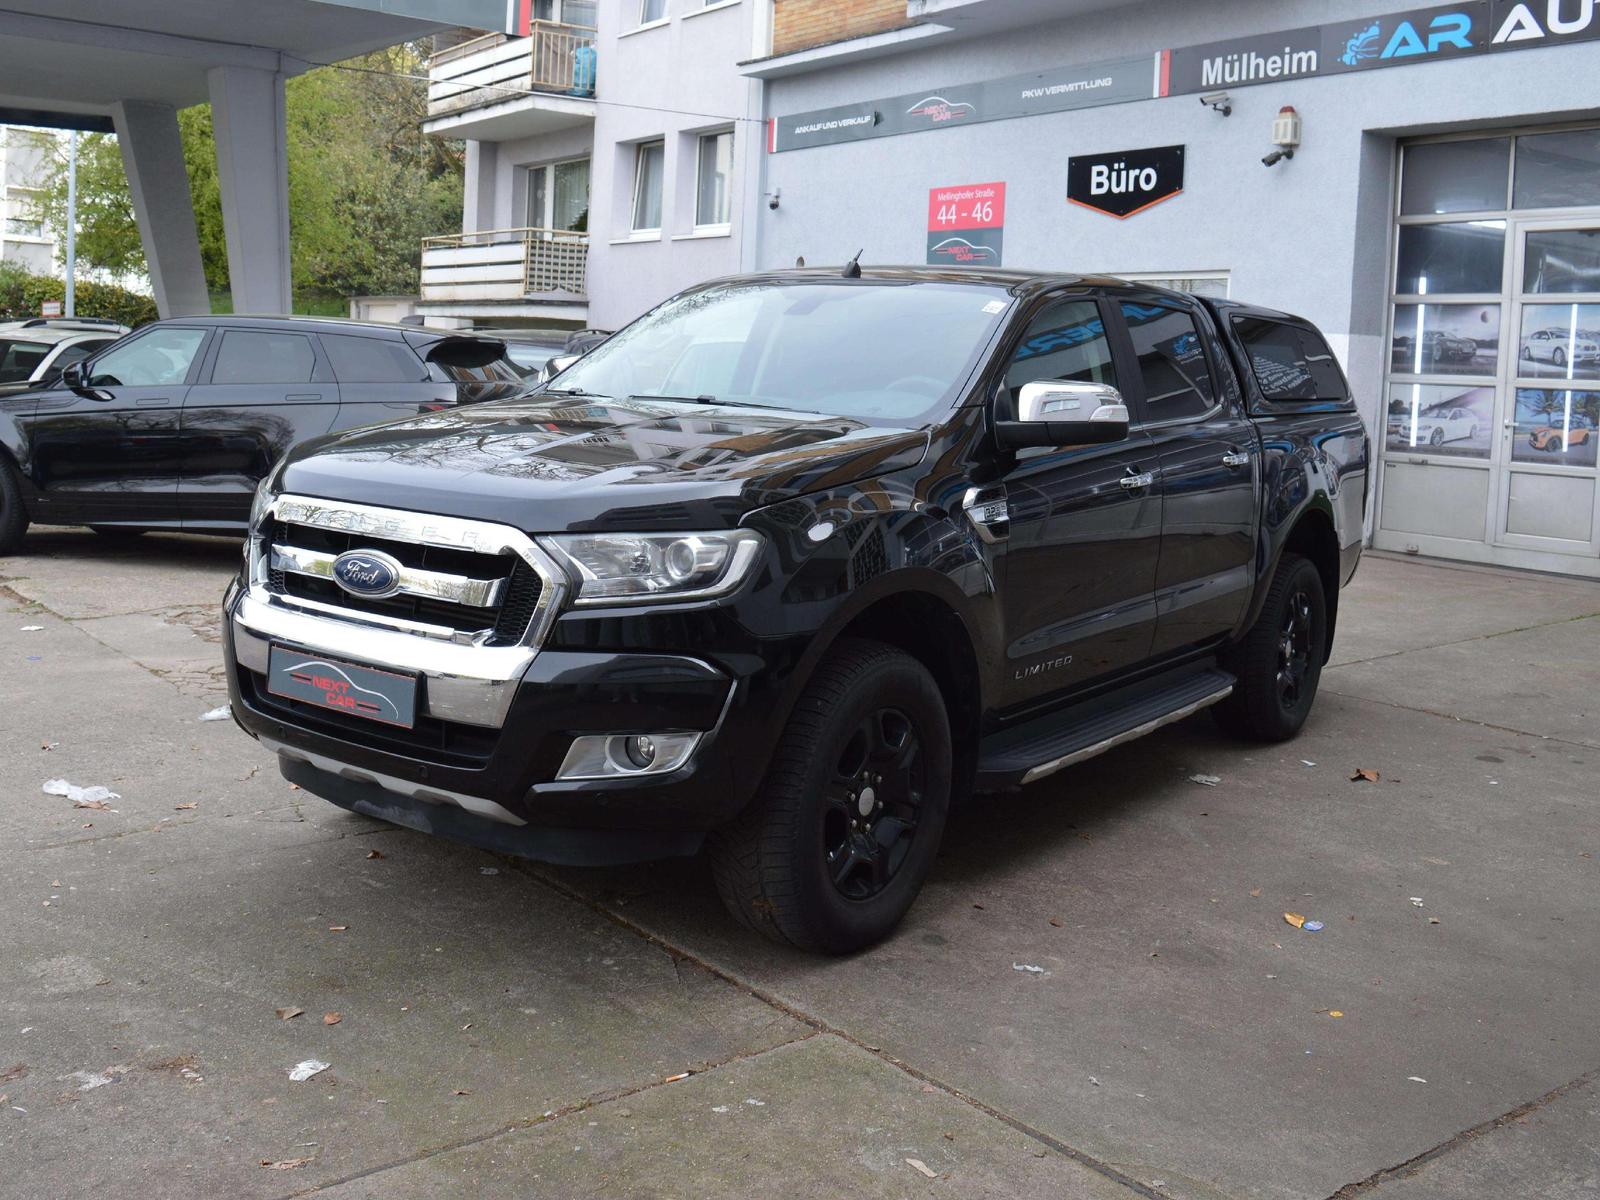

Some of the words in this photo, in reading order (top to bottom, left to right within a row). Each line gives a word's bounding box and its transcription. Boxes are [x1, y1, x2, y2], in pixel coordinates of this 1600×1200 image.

[1380, 13, 1473, 59] AR
[1491, 0, 1600, 44] AU
[1201, 46, 1318, 86] Mülheim
[1022, 87, 1044, 99] PKW
[1045, 77, 1113, 95] VERMITTLUNG
[795, 122, 822, 134] ANKAUF
[822, 120, 838, 130] UND
[838, 115, 871, 127] VERKAUF
[1090, 163, 1158, 195] Büro
[937, 190, 974, 203] Mellinghofer
[975, 188, 995, 199] Straße
[937, 204, 957, 225] 44
[971, 200, 993, 223] 46
[343, 559, 379, 585] Ford
[1015, 655, 1073, 680] LIMITED
[312, 675, 350, 693] NEXT
[326, 692, 357, 709] CAR
